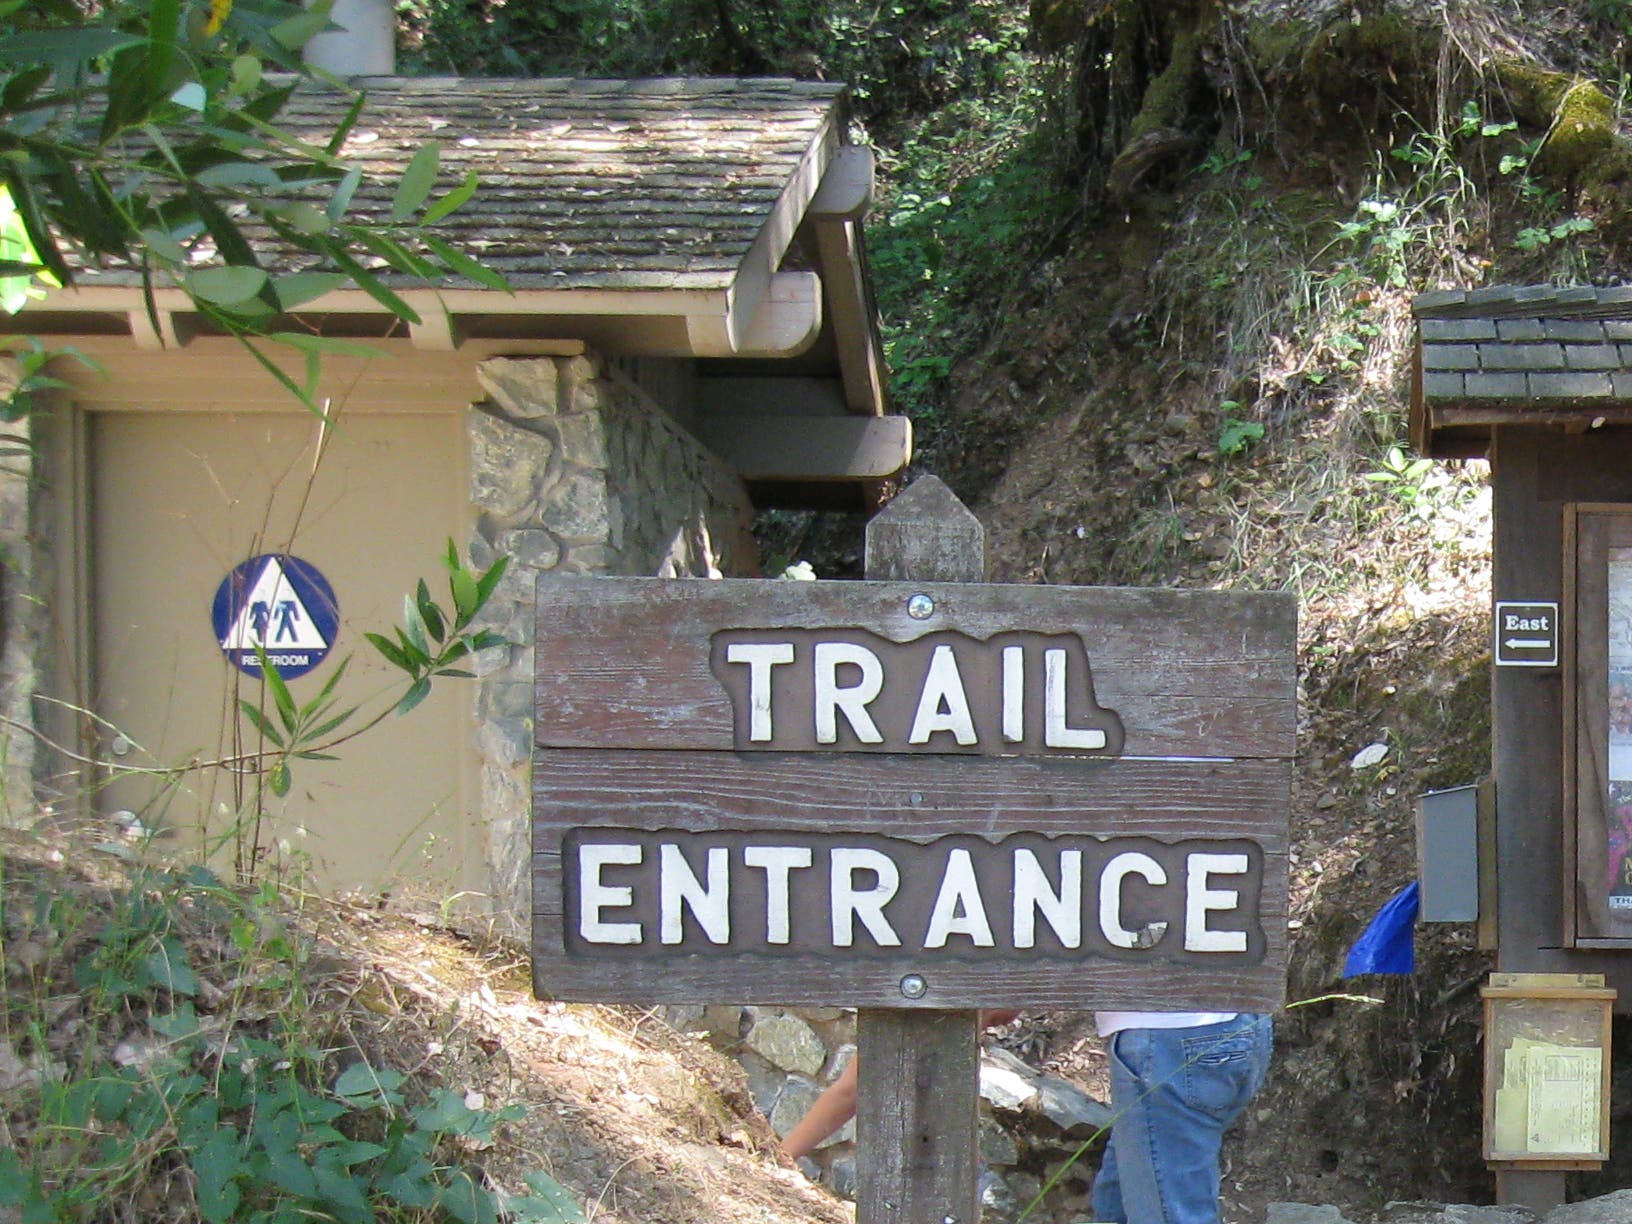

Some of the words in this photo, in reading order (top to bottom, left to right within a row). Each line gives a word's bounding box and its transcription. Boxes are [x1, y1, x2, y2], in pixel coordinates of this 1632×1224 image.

[1505, 615, 1549, 631] East
[726, 643, 1106, 750] TRAIL
[578, 842, 1249, 953] ENTRANCE
